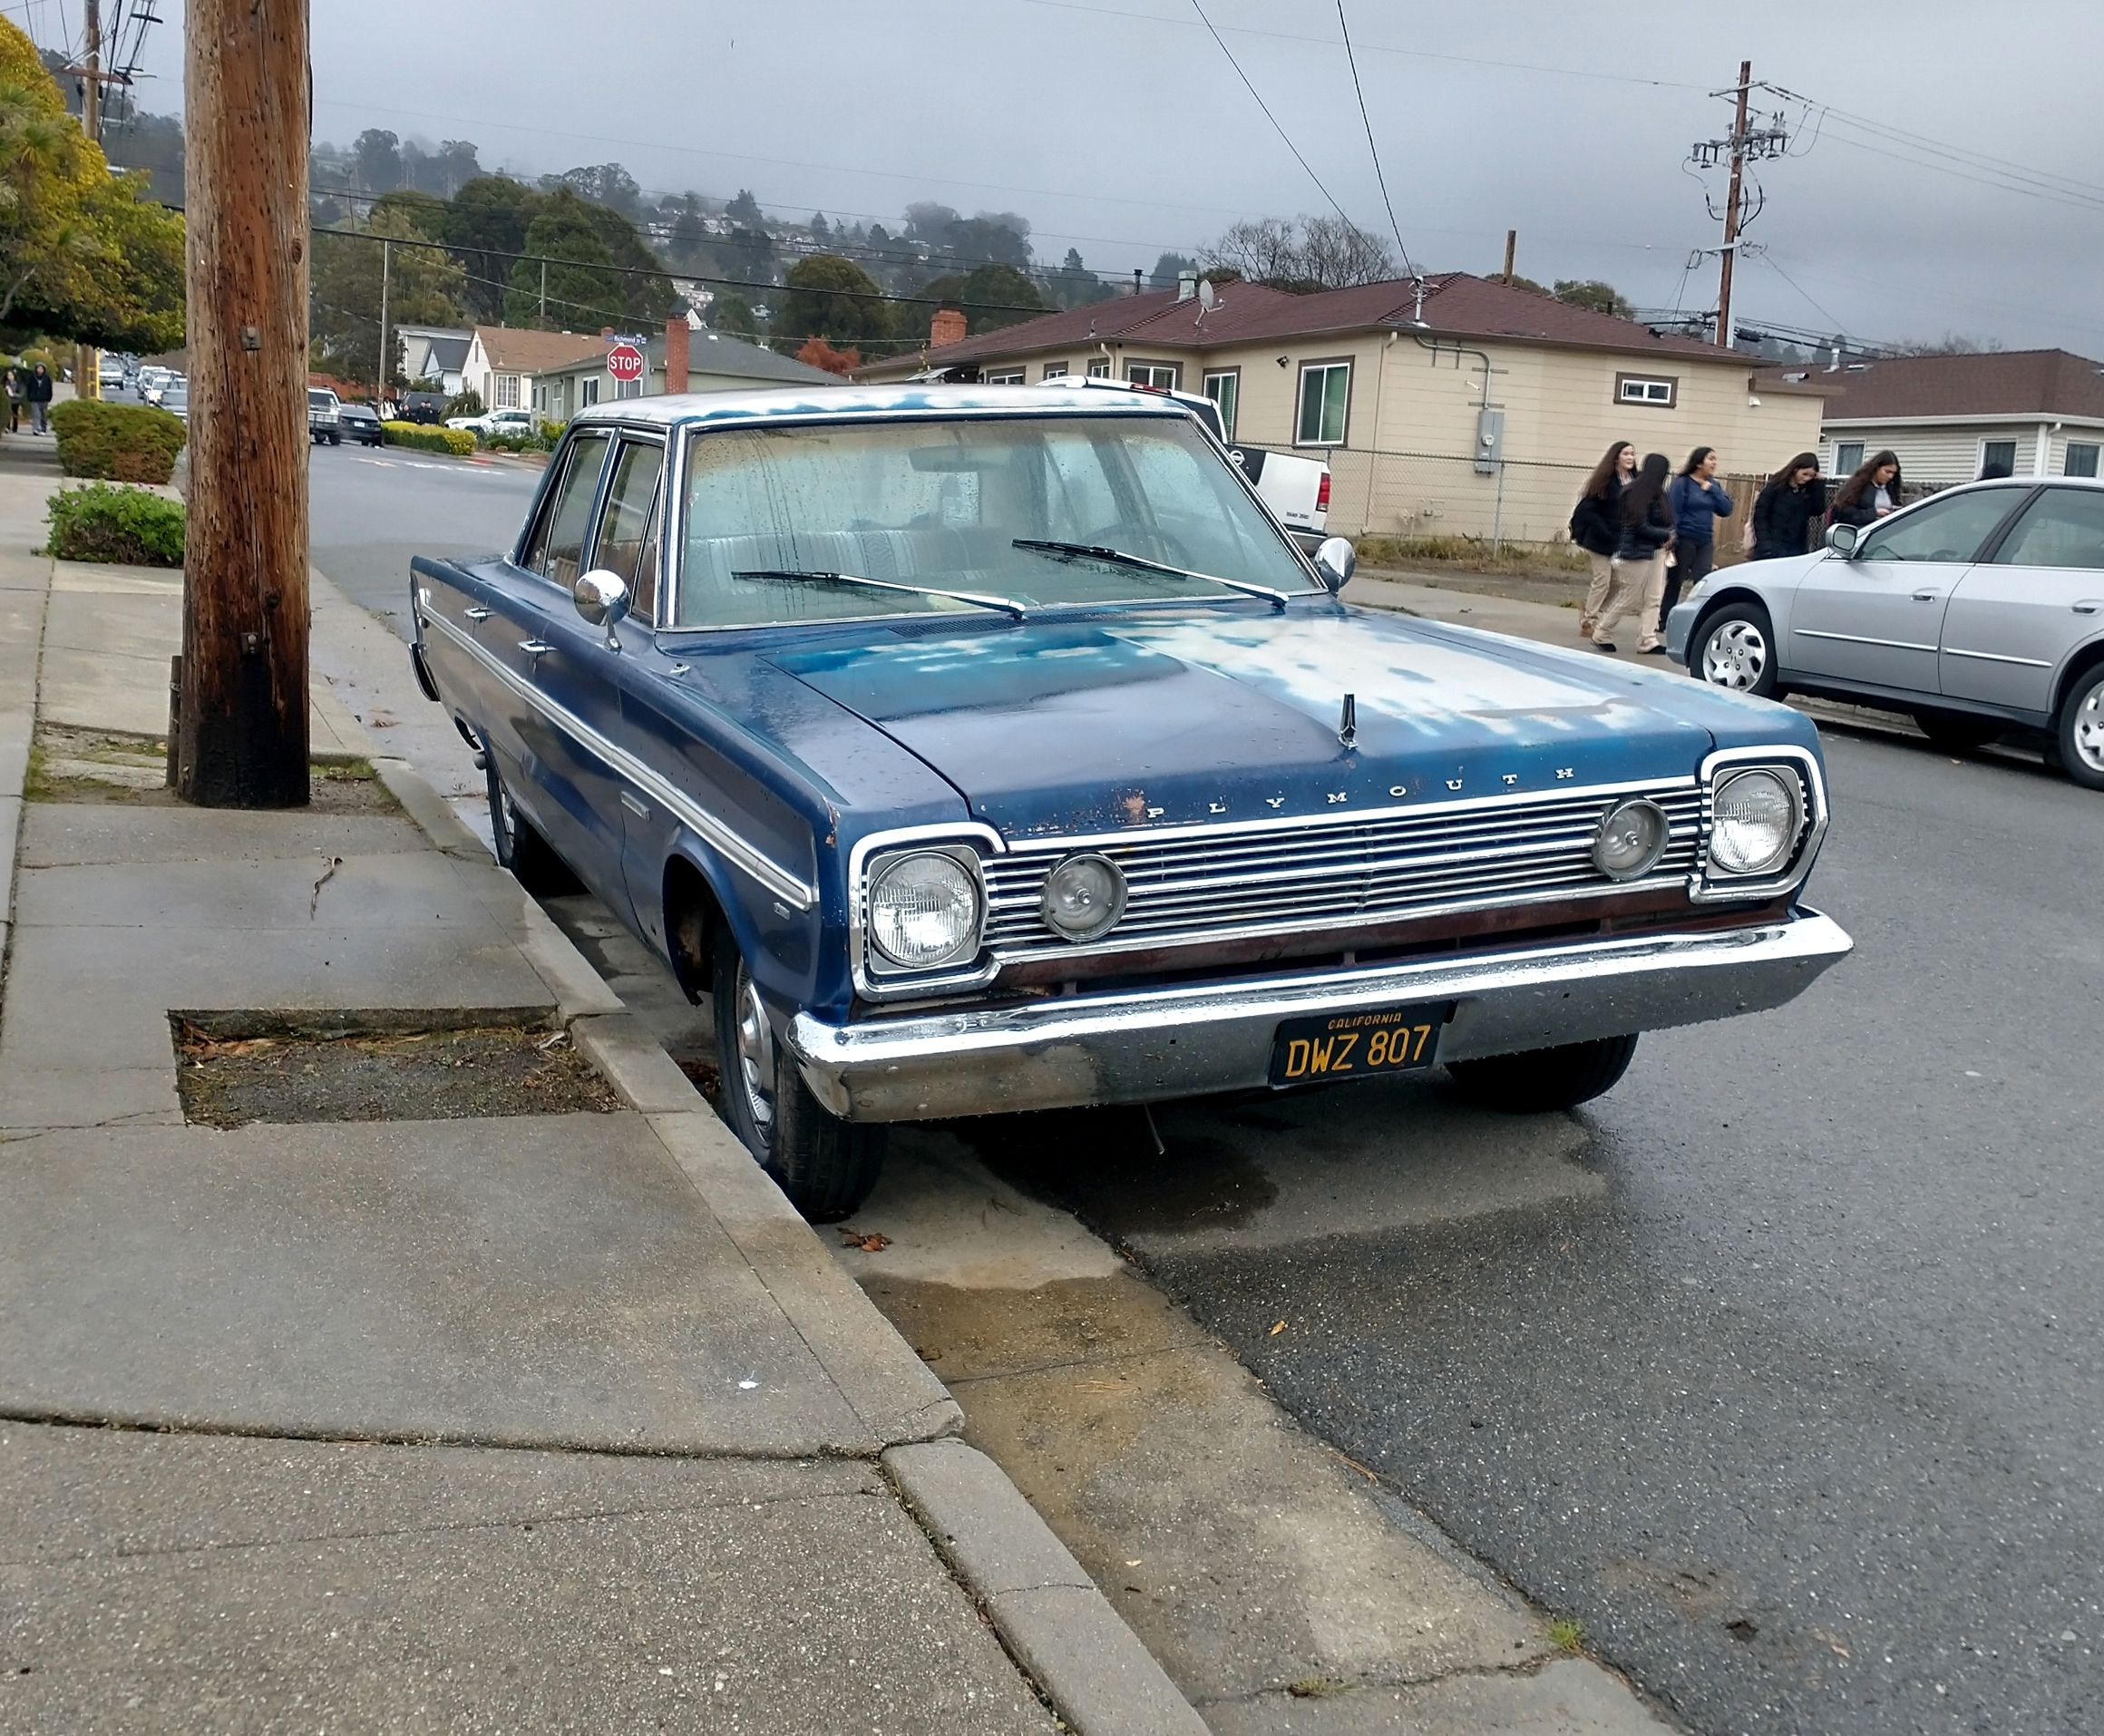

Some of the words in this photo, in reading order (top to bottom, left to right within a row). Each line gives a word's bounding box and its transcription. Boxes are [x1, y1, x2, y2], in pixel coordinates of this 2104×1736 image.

[610, 356, 640, 370] STOP
[1146, 767, 1574, 819] PLYMOUTH
[1328, 1012, 1402, 1030] CALIFORNIA
[1285, 1033, 1359, 1078] DWZ
[1368, 1024, 1431, 1067] 807
